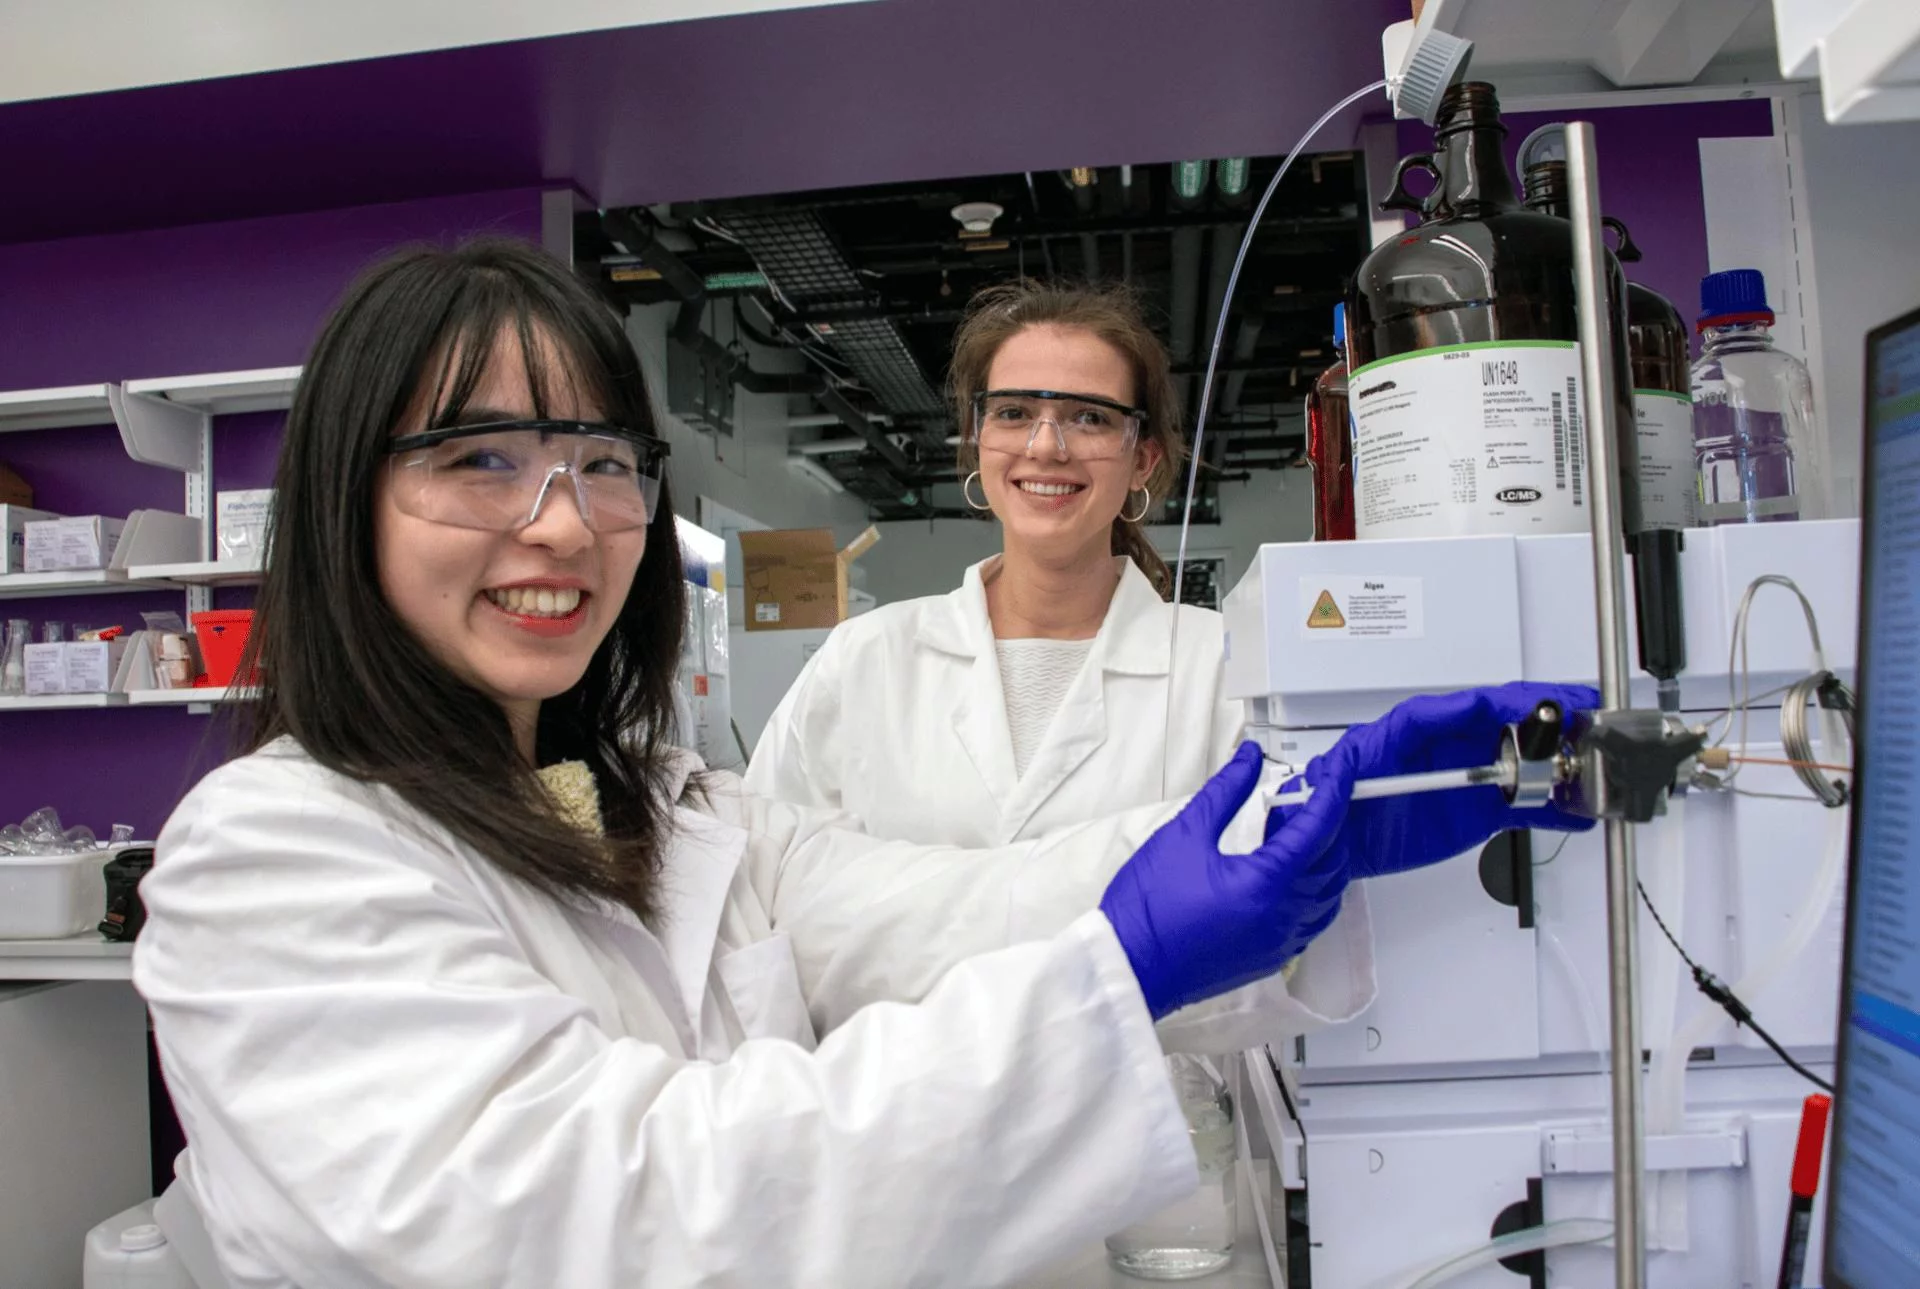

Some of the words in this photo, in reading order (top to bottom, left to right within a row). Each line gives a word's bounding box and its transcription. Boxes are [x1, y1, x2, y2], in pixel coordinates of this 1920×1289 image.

[1482, 361, 1518, 386] UN1648
[1500, 490, 1537, 501] LC/MS
[1364, 582, 1384, 590] Algae
